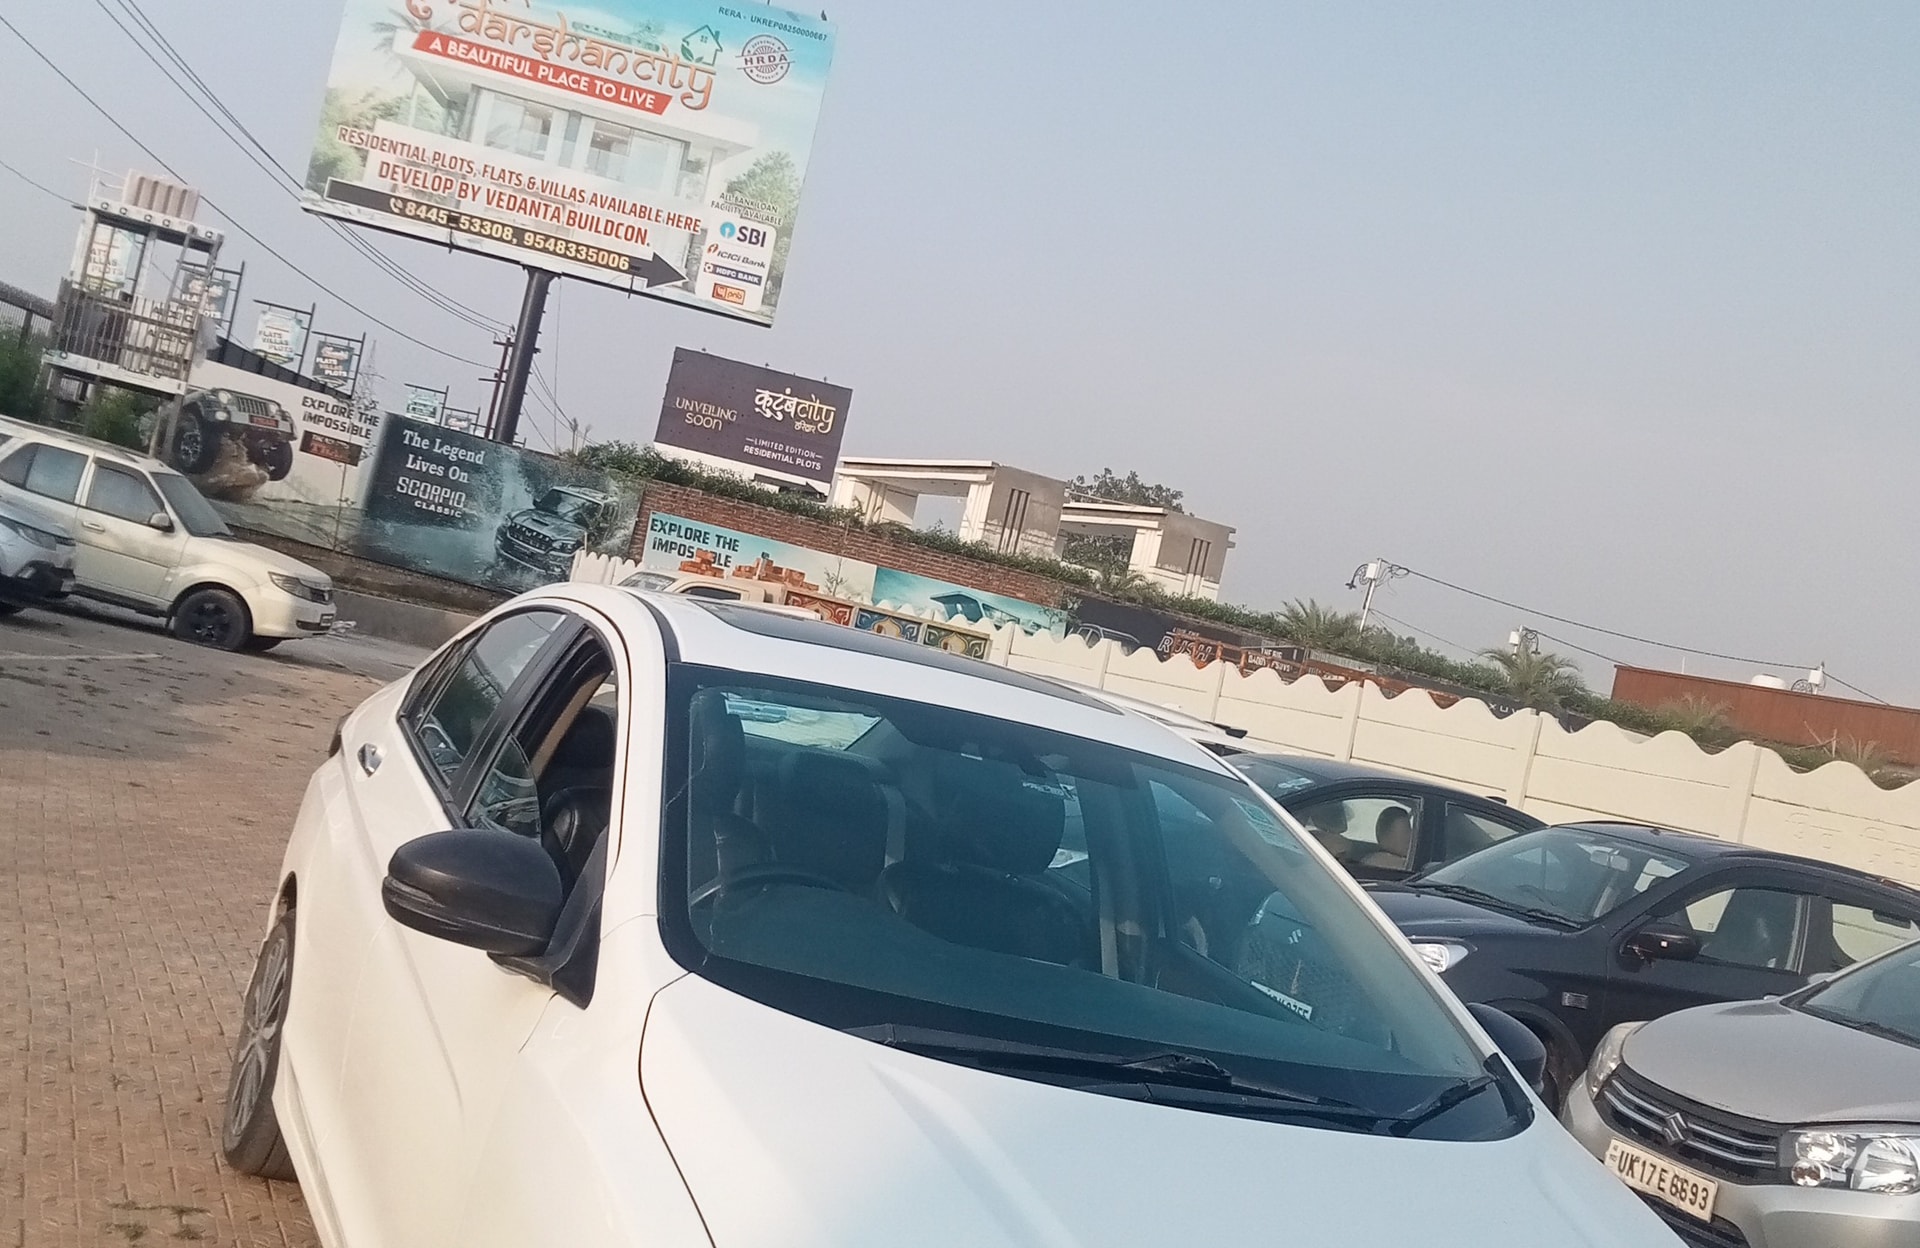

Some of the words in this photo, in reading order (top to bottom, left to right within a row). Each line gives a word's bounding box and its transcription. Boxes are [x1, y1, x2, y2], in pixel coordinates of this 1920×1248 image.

[429, 37, 443, 52] A
[447, 40, 533, 77] BEAUTIFUL
[538, 66, 590, 92] PLACE
[595, 80, 616, 98] TO
[620, 88, 656, 109] LIVE
[744, 53, 788, 66] HRDA
[338, 127, 428, 163] RESIDENTIAL
[432, 151, 478, 177] PLOTS,
[482, 164, 523, 187] FLATS
[527, 176, 536, 190] &
[540, 179, 586, 204] VILLAS
[588, 193, 664, 223] AVAILABLE
[665, 212, 702, 232] HERE
[379, 161, 454, 194] DEVELOP
[457, 181, 482, 202] BY
[486, 188, 561, 224] VEDANTA
[566, 209, 651, 247] BUILDCON.
[744, 209, 783, 226] AVAILABLE
[737, 226, 766, 248] SBI
[523, 232, 630, 271] 9548335006
[741, 256, 766, 269] Bank
[716, 267, 736, 278] HDFC
[738, 273, 760, 284] BANK
[302, 396, 354, 420] EXPLORE
[357, 411, 381, 428] THE
[676, 397, 738, 422] UNVEILING
[402, 429, 430, 449] The
[433, 438, 485, 465] Legend
[743, 445, 794, 464] RESIDENTIAL
[795, 457, 822, 471] PLOTS
[754, 438, 784, 451] LIMITED
[785, 445, 816, 459] EDITION
[406, 454, 444, 477] Lives
[448, 466, 470, 483] On
[396, 476, 466, 508] SCORPIO
[414, 500, 462, 518] CLASSIC
[650, 518, 710, 545] EXPLORE
[715, 534, 740, 552] THE
